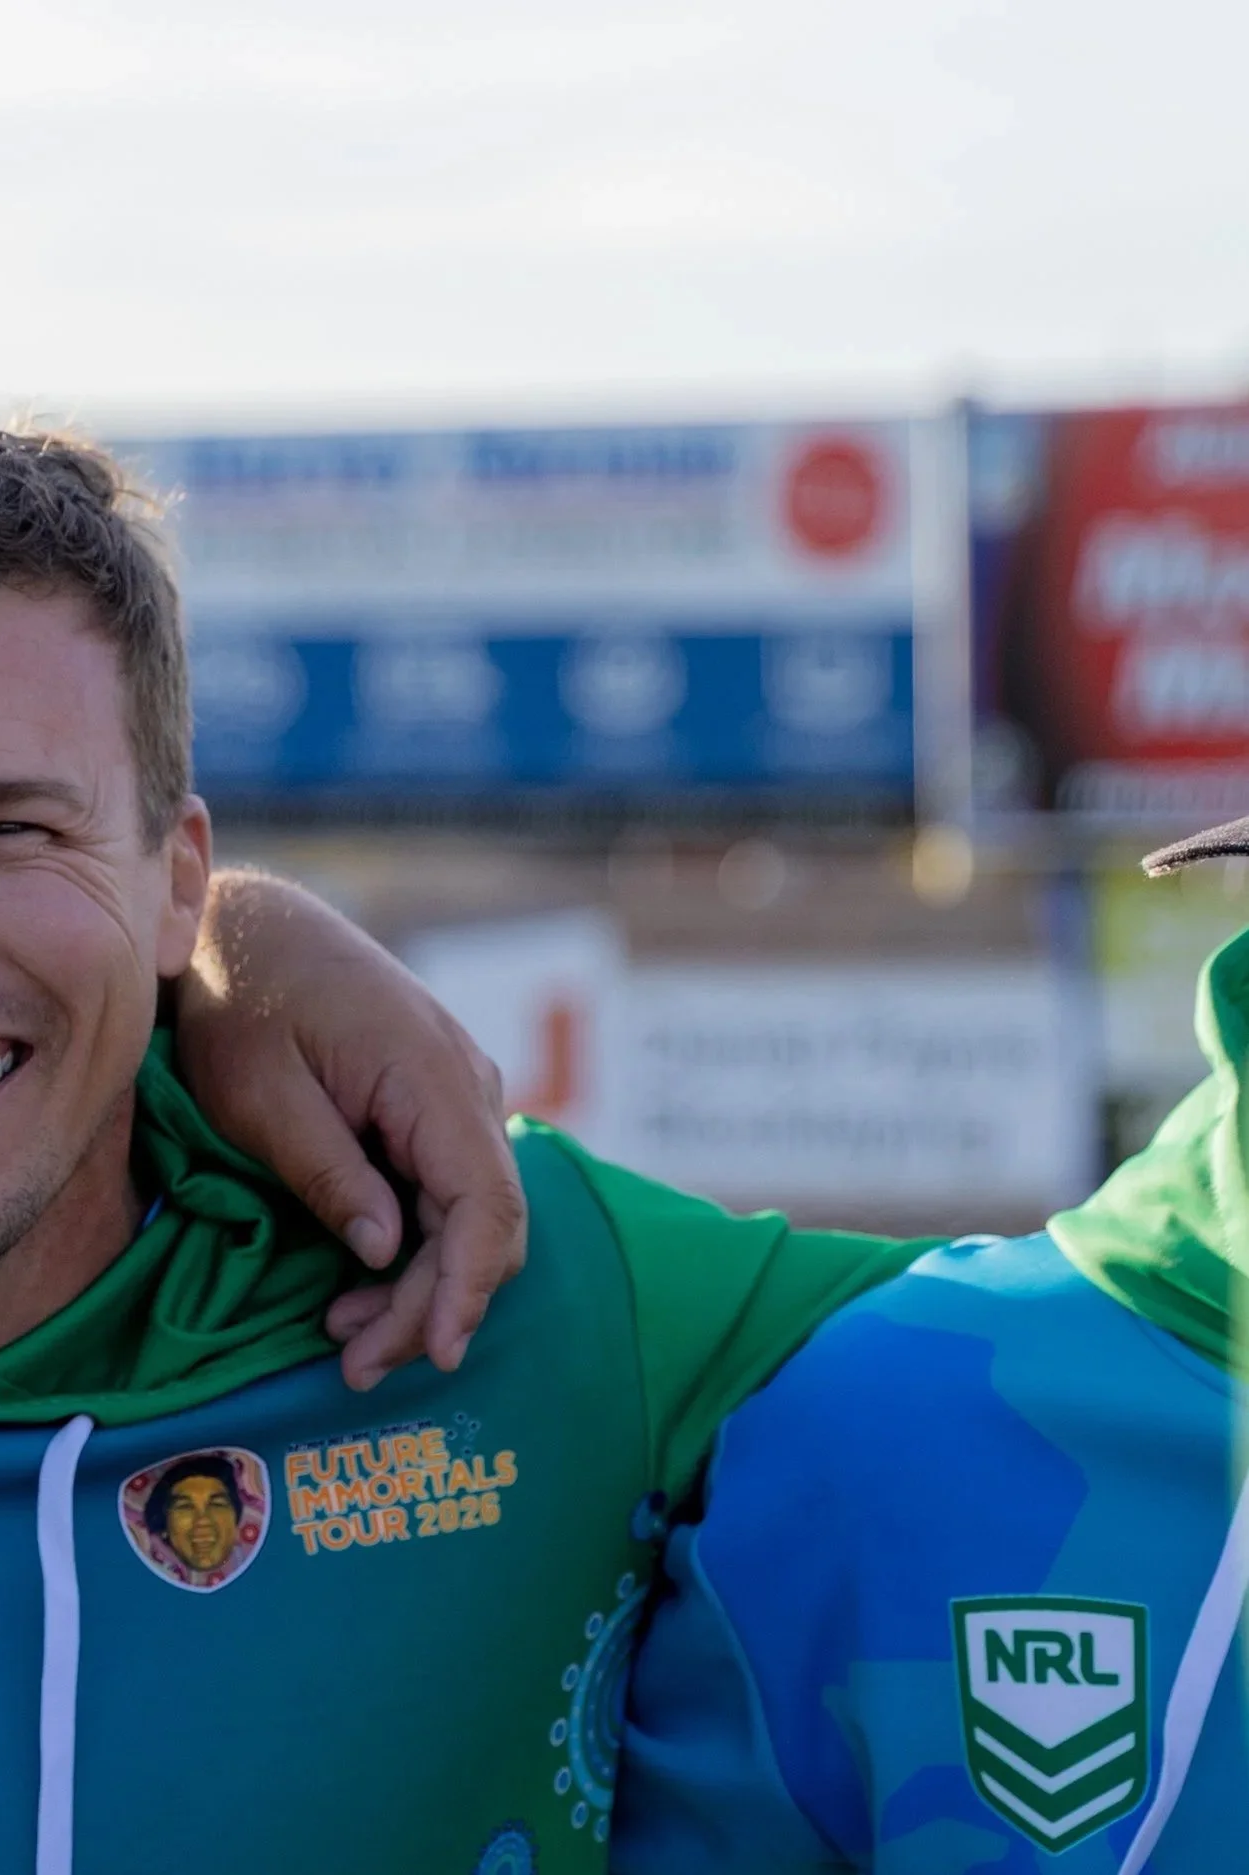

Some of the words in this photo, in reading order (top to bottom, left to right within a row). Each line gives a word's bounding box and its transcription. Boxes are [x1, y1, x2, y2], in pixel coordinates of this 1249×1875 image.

[286, 1429, 448, 1486] FUTURE
[289, 1450, 517, 1520] IMMORTALS
[293, 1508, 410, 1555] TOUR
[415, 1493, 500, 1537] 2026
[985, 1629, 1119, 1686] NRL
